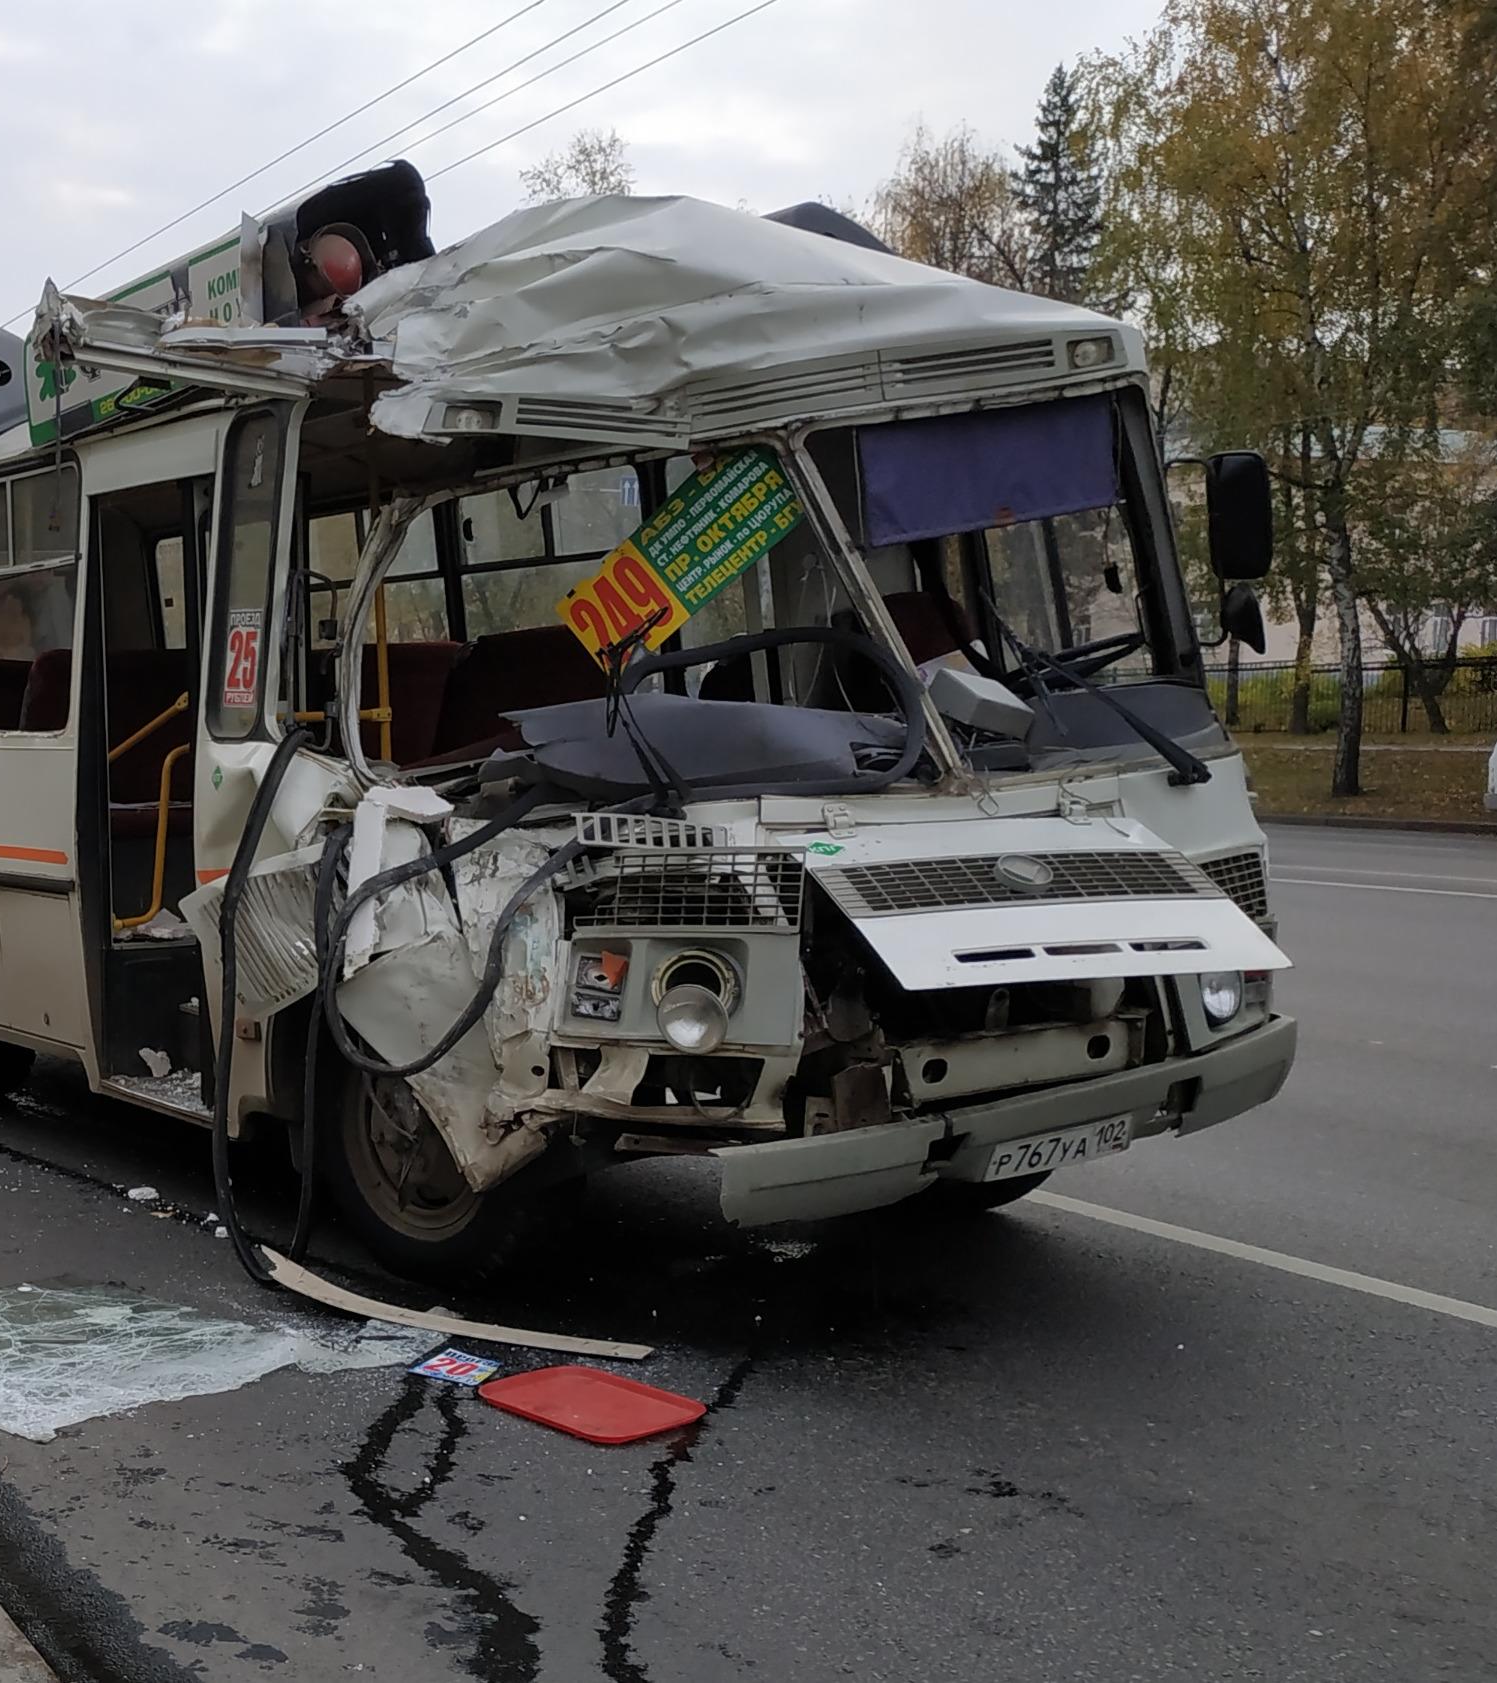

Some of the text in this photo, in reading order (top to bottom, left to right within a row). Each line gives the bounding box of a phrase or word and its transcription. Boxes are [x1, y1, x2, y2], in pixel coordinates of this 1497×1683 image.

[207, 267, 240, 300] КОМ
[689, 449, 759, 518] ПЕРВОМАЙСКАЯ
[719, 460, 769, 511] КОМАРОВА
[747, 488, 793, 530] ЦЮРУПА
[640, 498, 685, 546] АБЗ
[664, 468, 784, 582] ПР. ОКТЯБРЯ
[685, 530, 767, 605] ТЕЛЕЦЕНТР
[570, 556, 673, 668] 249
[227, 630, 258, 690] 25
[423, 1357, 479, 1376] 20
